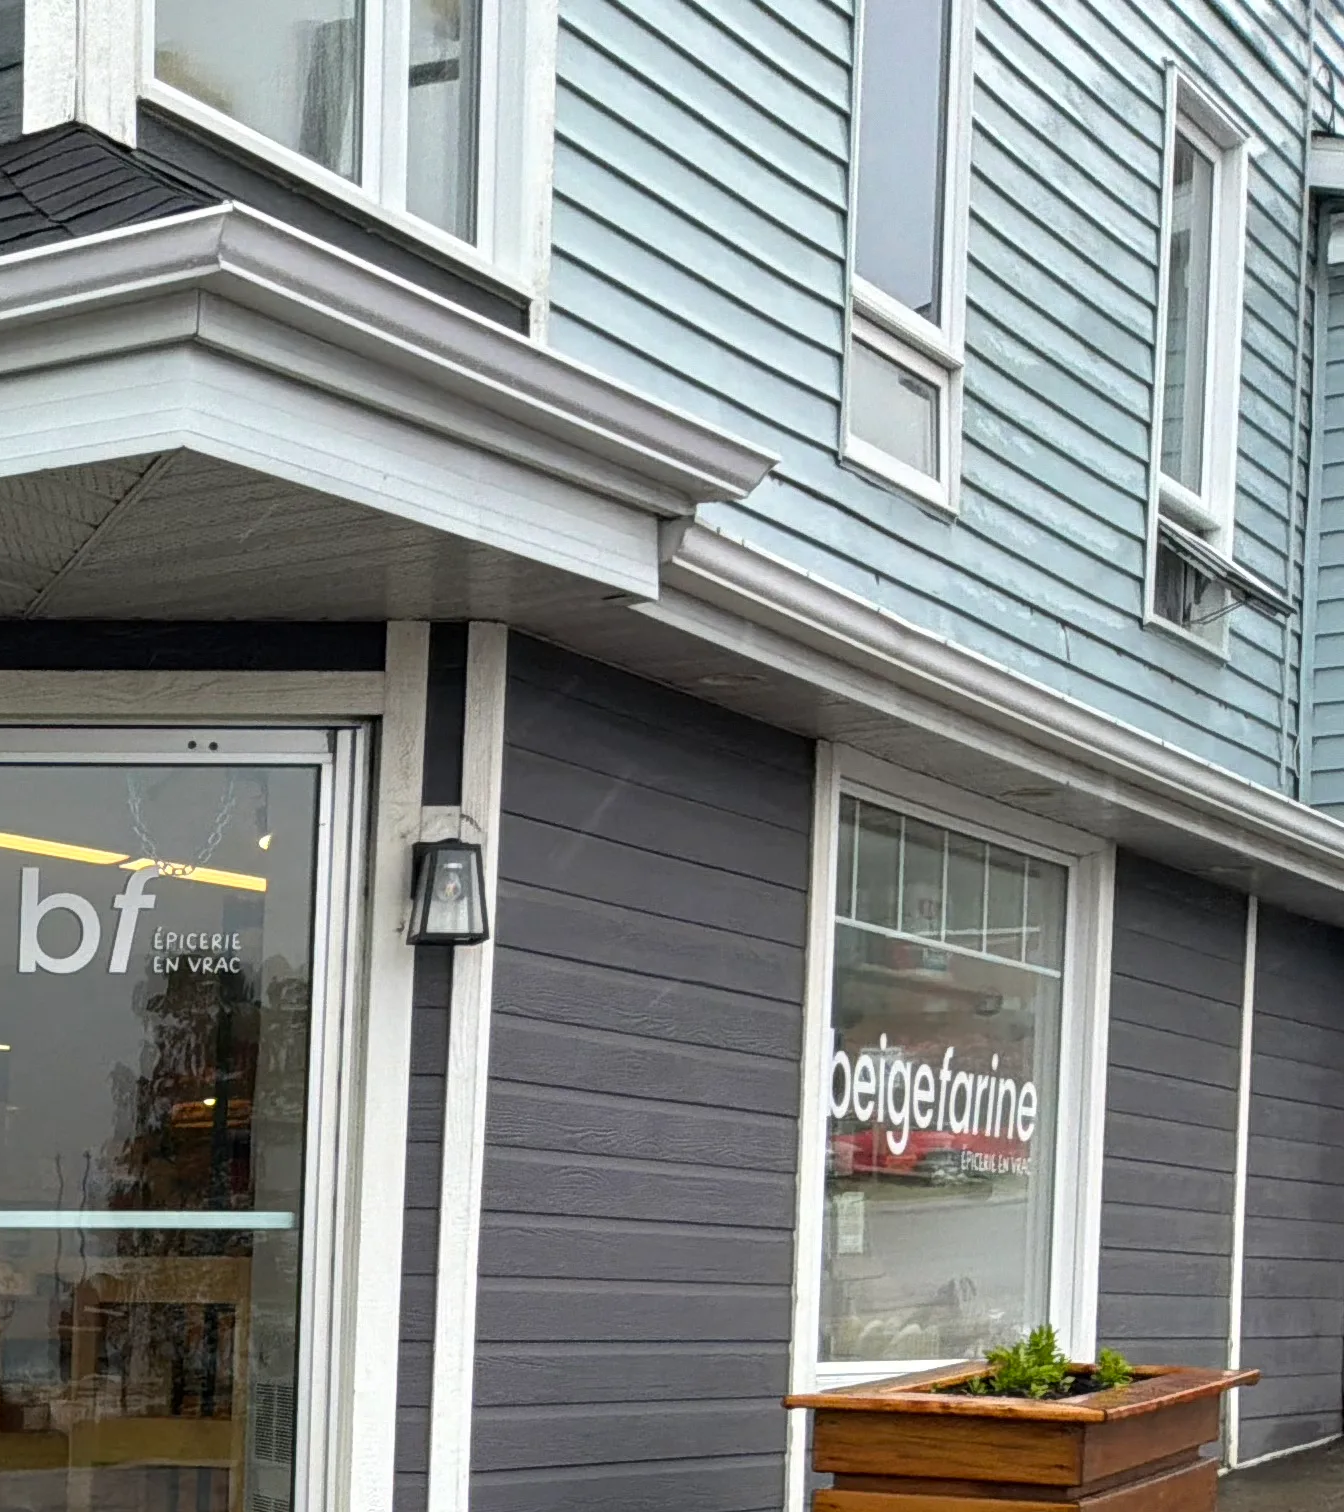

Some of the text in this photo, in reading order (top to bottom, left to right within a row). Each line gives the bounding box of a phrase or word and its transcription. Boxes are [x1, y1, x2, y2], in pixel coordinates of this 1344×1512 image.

[19, 867, 159, 973] bf
[153, 926, 242, 950] ÉPICERIE
[153, 956, 241, 975] EN VRAC
